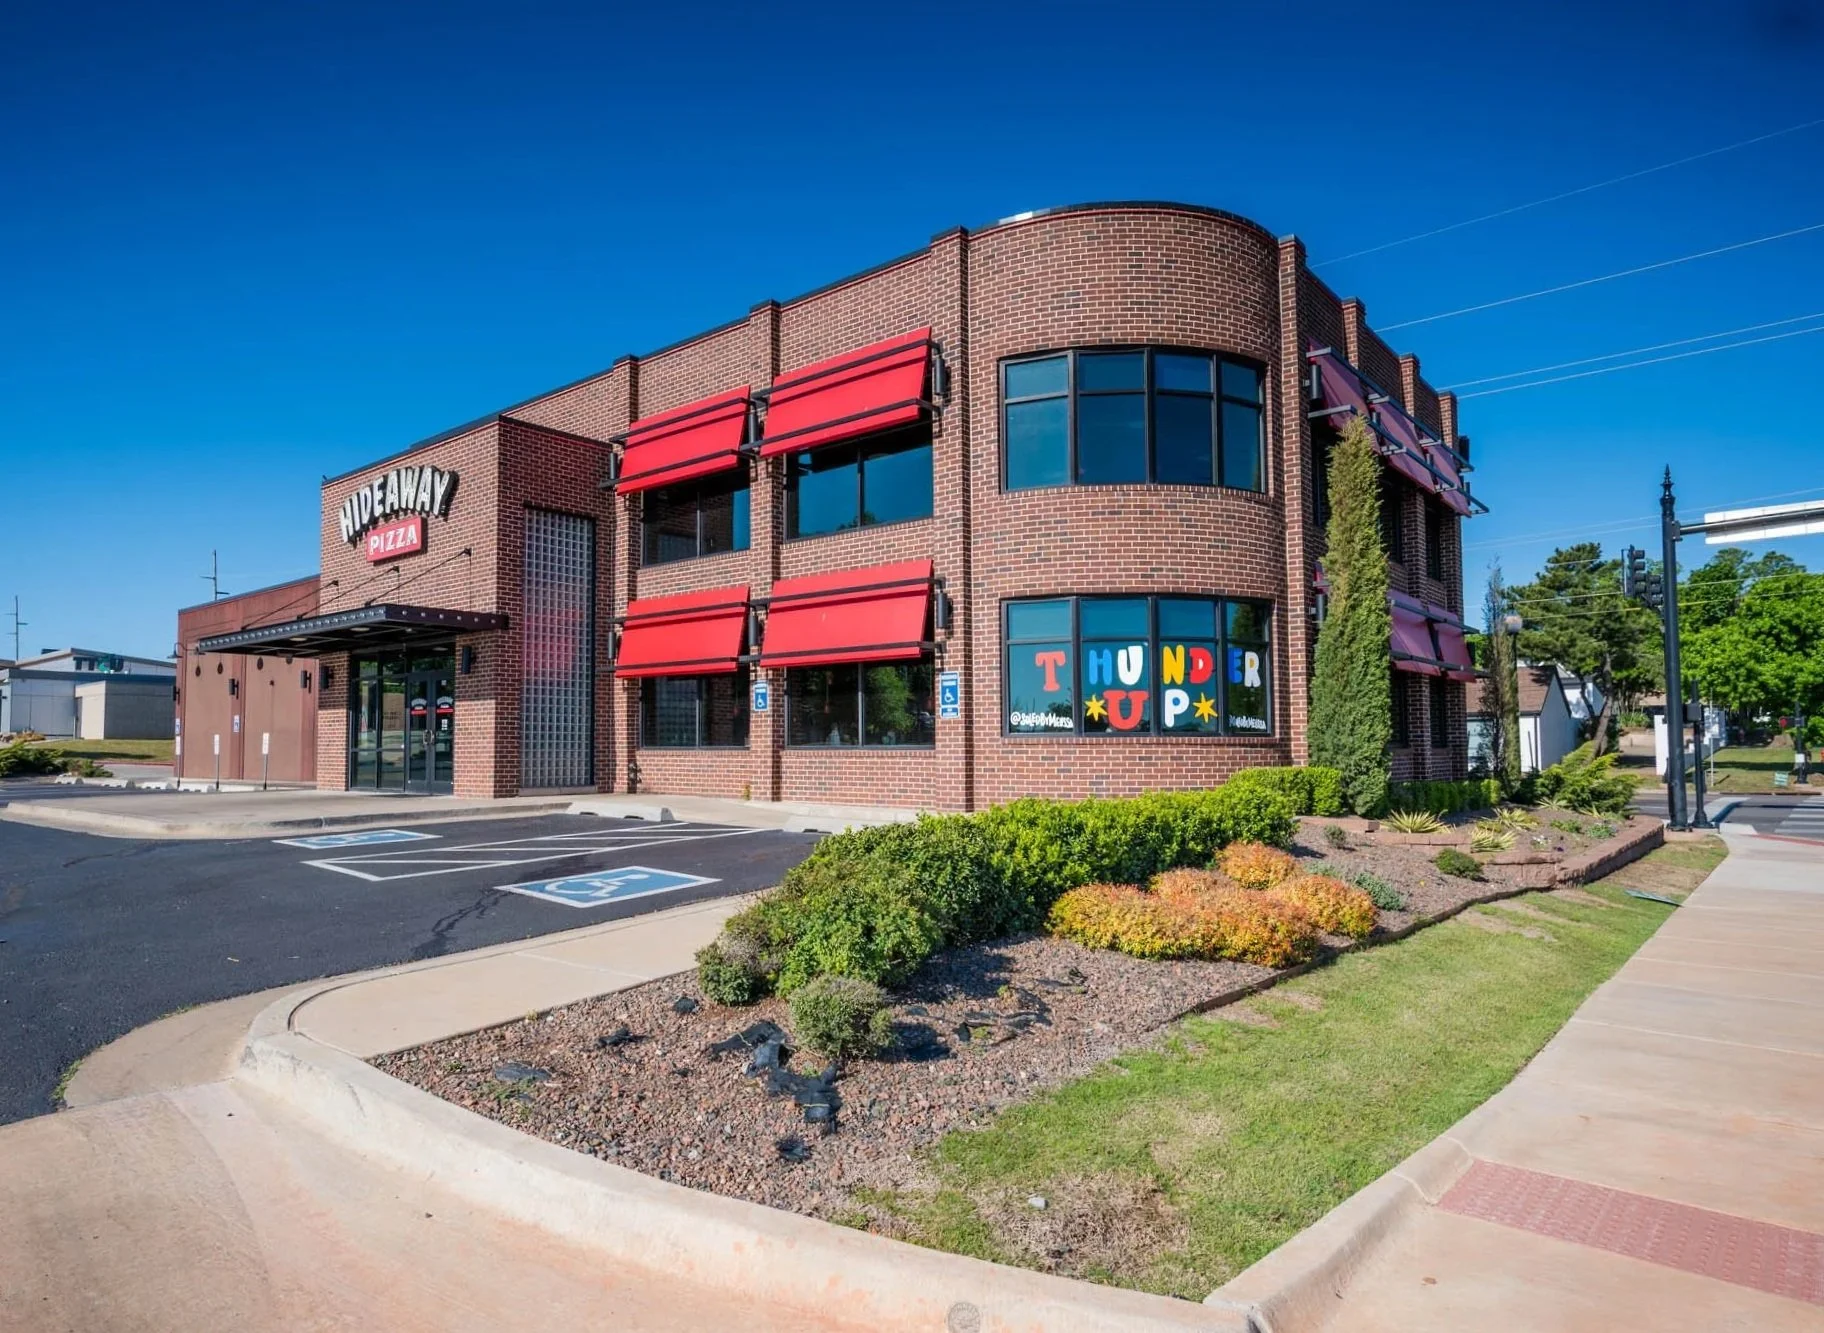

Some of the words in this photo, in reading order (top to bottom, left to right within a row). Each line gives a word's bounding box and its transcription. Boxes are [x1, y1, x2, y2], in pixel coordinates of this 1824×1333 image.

[338, 466, 451, 544] HIDEAWAY
[369, 524, 418, 556] PIZZA
[1035, 645, 1262, 692] THUNDER
[1103, 689, 1190, 730] UP
